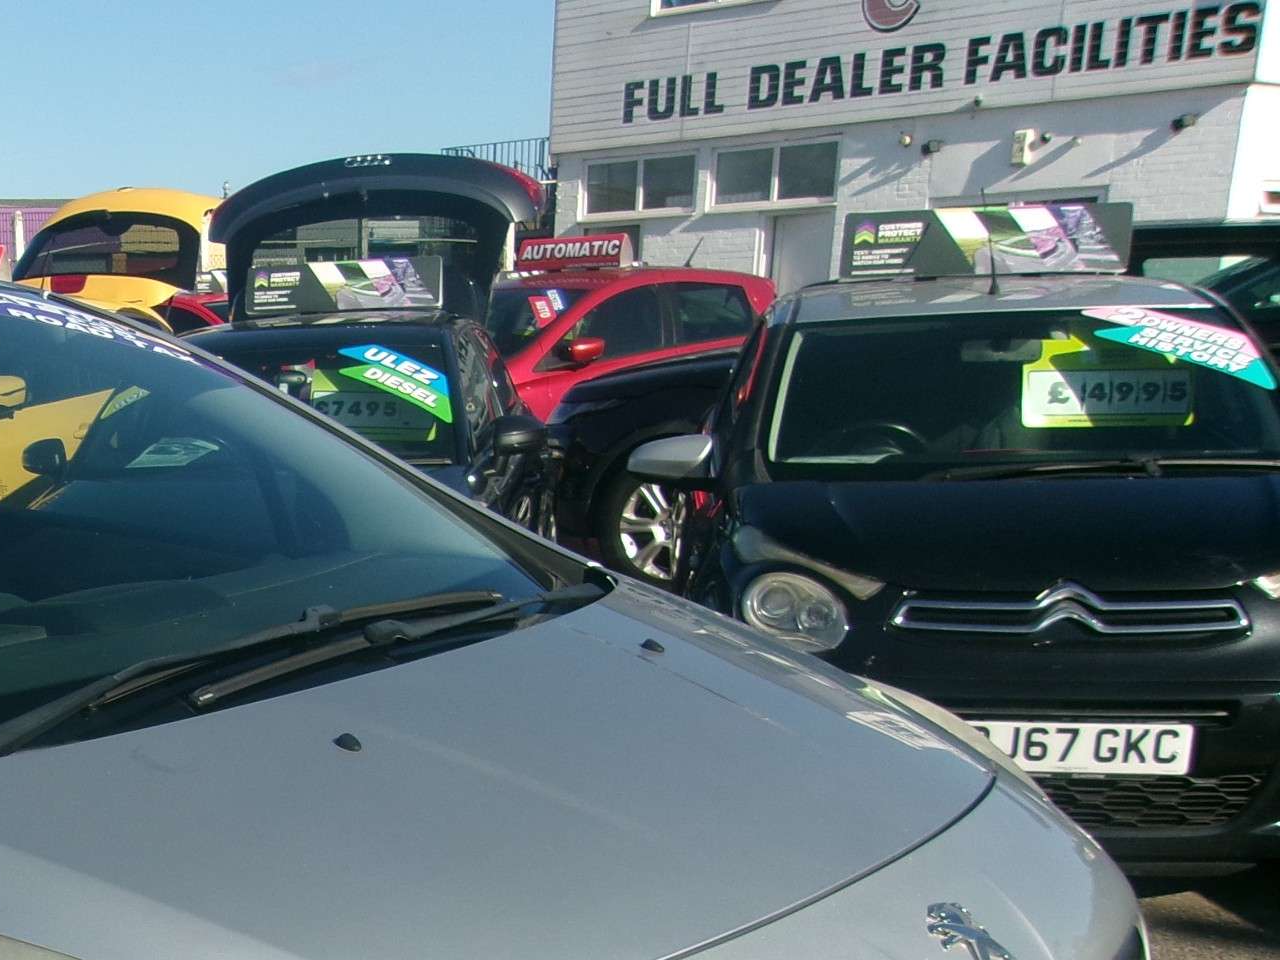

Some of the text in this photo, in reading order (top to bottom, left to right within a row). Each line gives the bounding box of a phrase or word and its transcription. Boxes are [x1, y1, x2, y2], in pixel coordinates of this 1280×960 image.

[623, 1, 1262, 124] FULL DEALER FACILITIES
[521, 240, 620, 260] AUTOMATIC
[1107, 308, 1246, 350] 2 OWNERS
[1140, 327, 1254, 366] SERVICE
[363, 348, 439, 385] ULEZ
[1127, 333, 1249, 372] HISTORY
[363, 368, 438, 407] DIESEL
[1094, 728, 1180, 764] GKC
